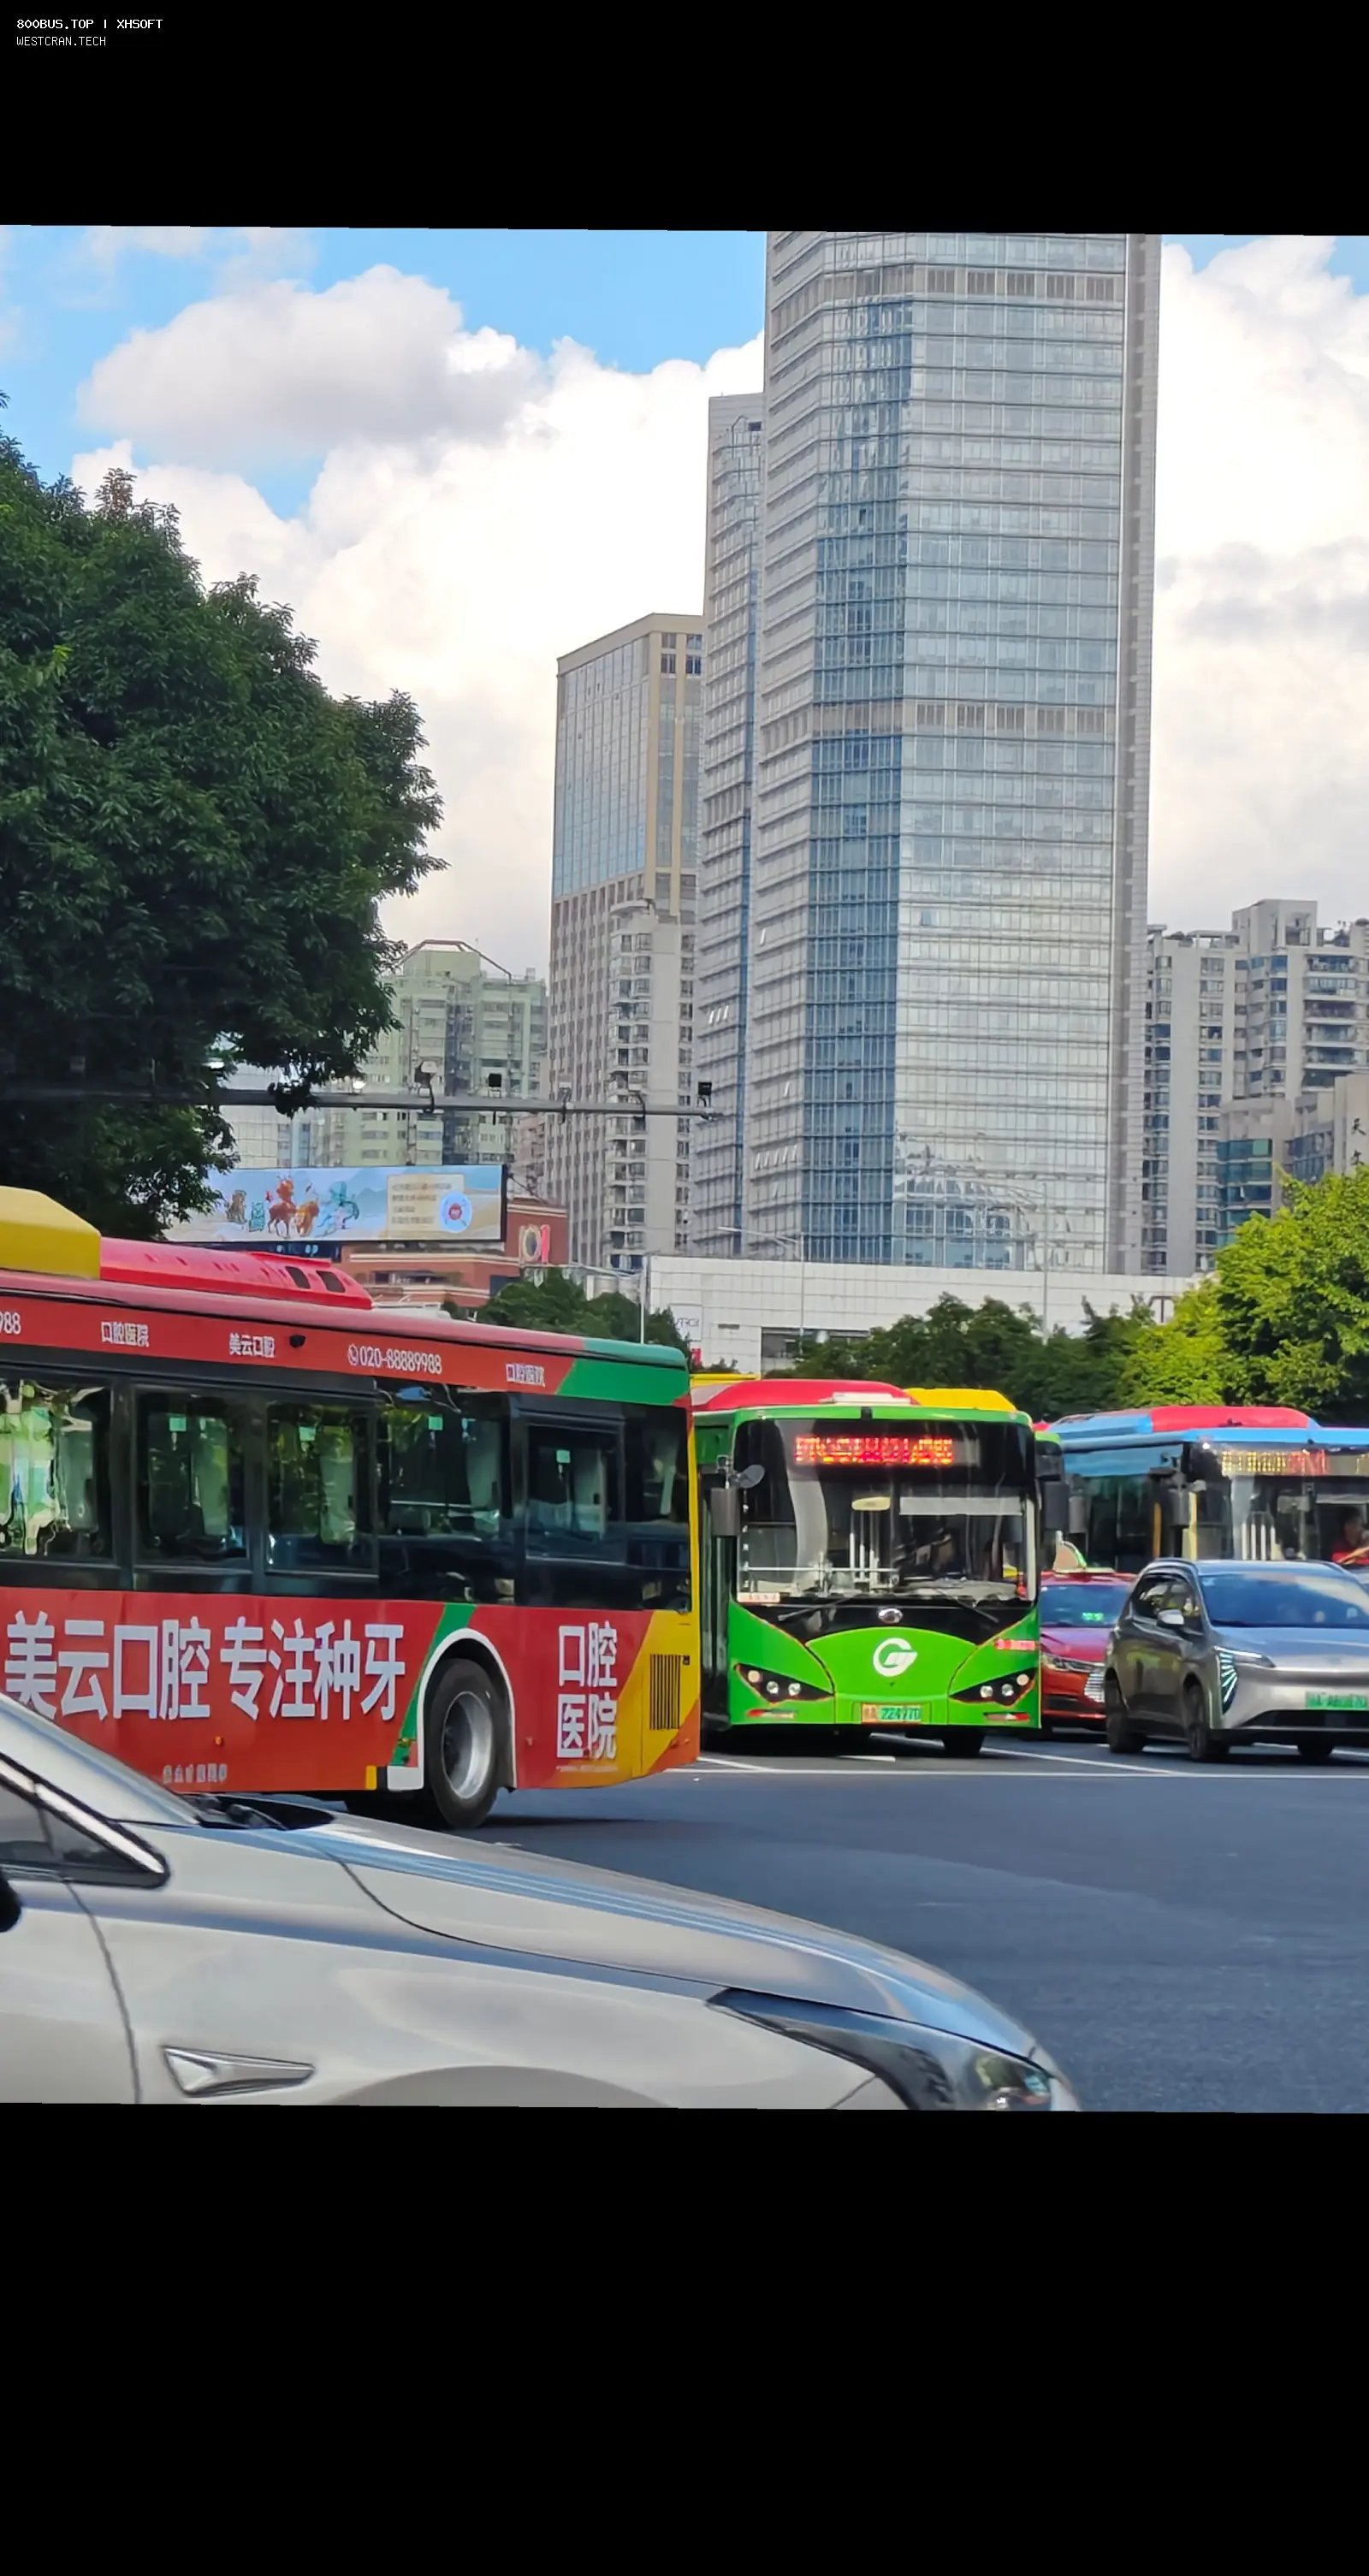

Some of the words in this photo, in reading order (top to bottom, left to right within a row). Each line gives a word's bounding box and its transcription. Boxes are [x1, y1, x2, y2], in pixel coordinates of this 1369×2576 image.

[4, 1610, 210, 1720] 美云口腔
[220, 1615, 406, 1720] 专注种牙
[559, 1620, 618, 1687] 口腔
[557, 1691, 618, 1760] 医院
